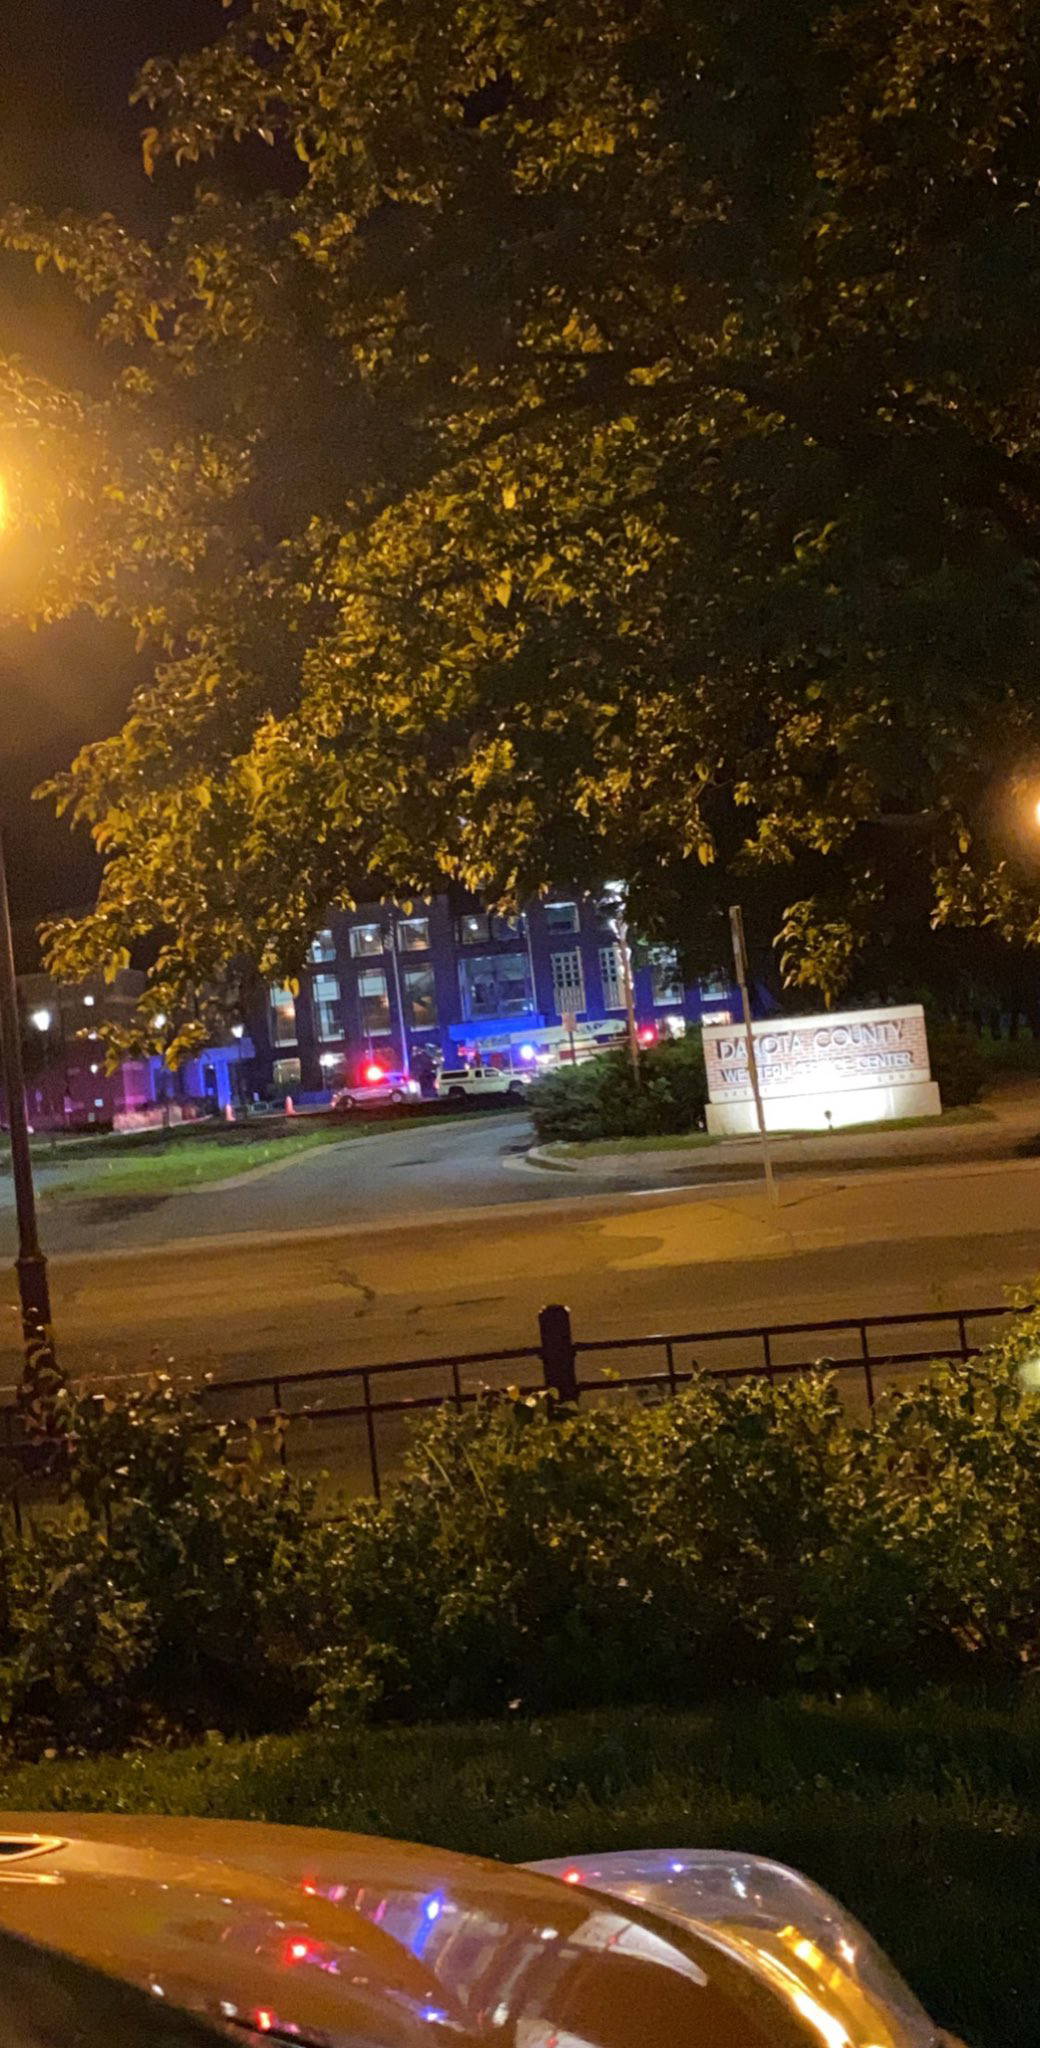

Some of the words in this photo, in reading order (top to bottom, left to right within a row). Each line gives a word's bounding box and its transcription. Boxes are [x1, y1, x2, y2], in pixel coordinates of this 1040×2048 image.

[813, 1018, 906, 1049] COUNTY
[720, 1061, 791, 1083] WETERN
[855, 1050, 914, 1068] CENTER
